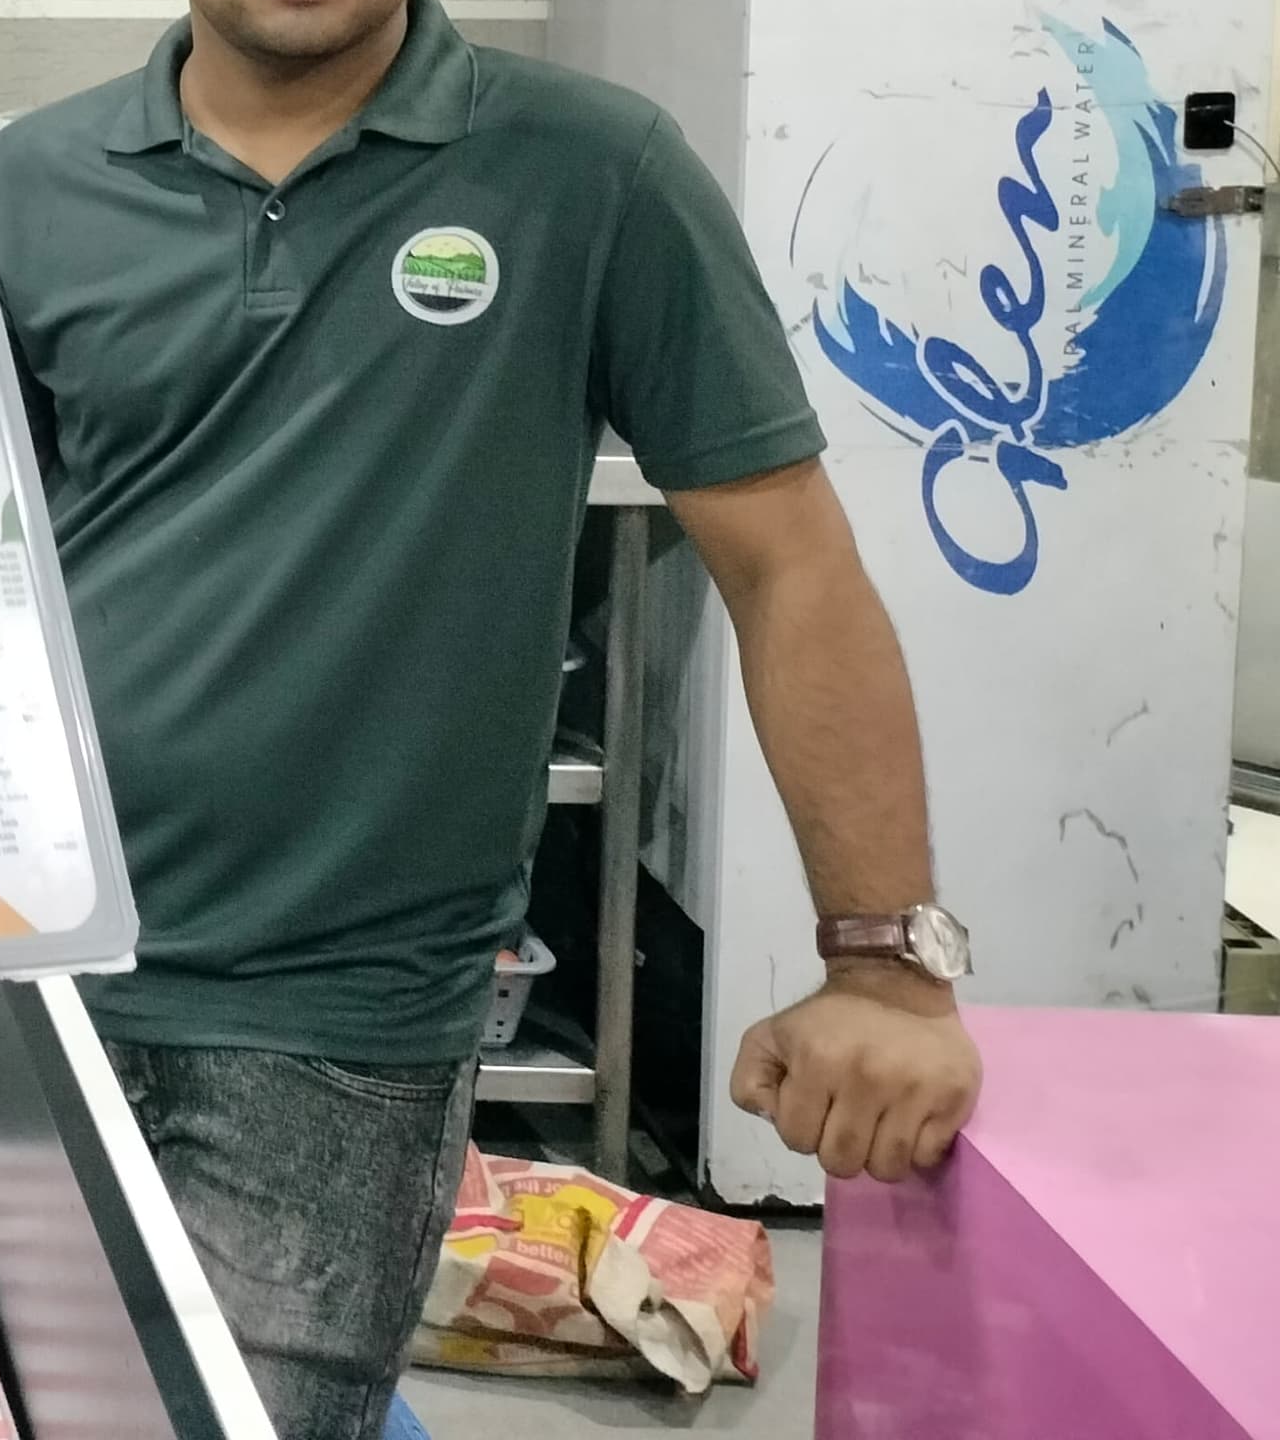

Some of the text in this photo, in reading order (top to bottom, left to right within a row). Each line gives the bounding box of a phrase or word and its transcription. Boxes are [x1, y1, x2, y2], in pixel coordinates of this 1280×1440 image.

[1074, 41, 1096, 138] WATER
[1066, 153, 1090, 290] MINERAL
[921, 86, 1070, 596] Glen
